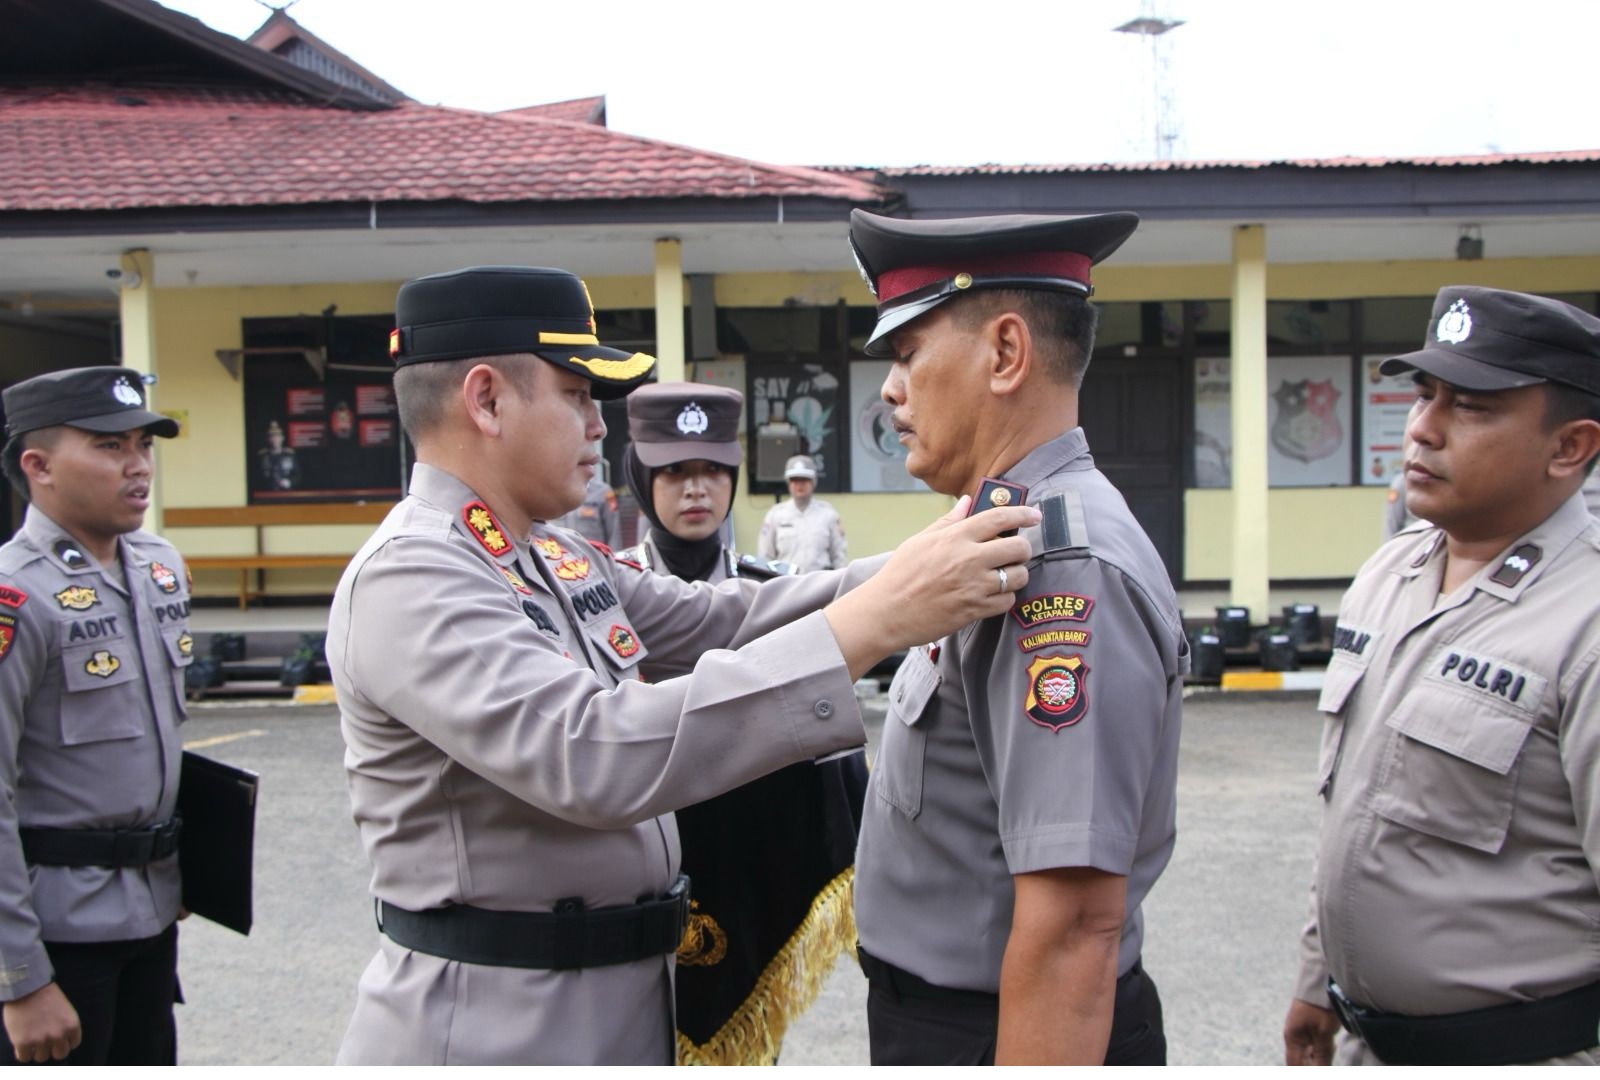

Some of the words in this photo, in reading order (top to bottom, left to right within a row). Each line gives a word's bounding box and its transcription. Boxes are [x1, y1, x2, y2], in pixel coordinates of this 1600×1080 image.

[754, 377, 790, 398] SAY
[1021, 597, 1085, 618] POLRES
[1031, 609, 1075, 622] KETAPANG
[69, 616, 118, 642] ADIT
[1022, 630, 1064, 649] KALIMANTAN
[1064, 632, 1087, 642] BARAT
[1441, 652, 1525, 702] POLRI
